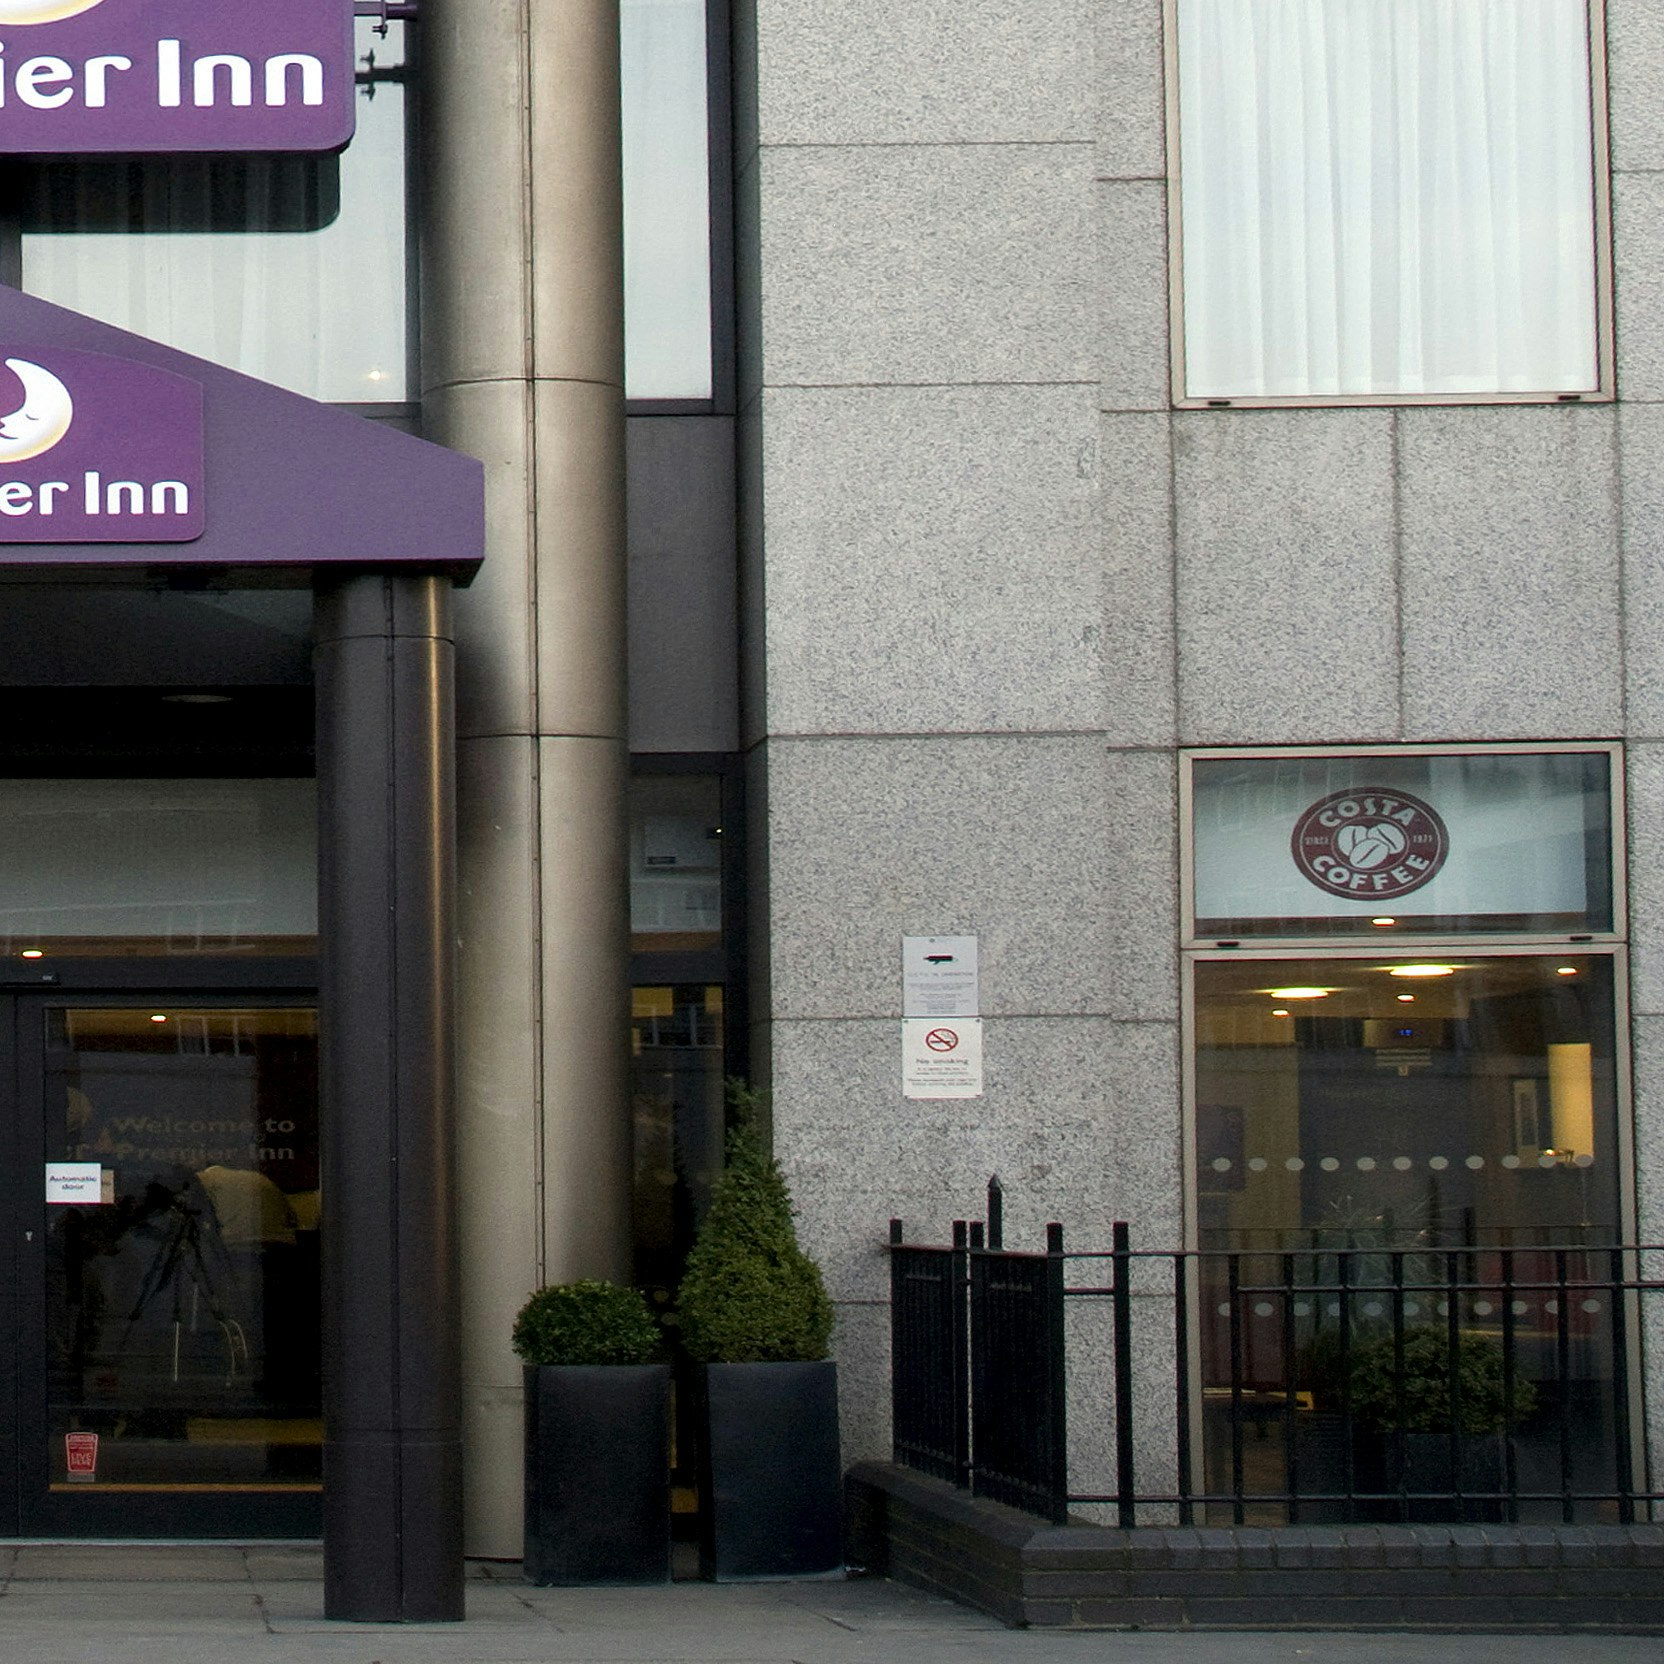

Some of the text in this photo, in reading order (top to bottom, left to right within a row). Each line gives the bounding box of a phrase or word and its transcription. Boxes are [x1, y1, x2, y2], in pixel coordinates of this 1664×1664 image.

[157, 38, 324, 108] Inn
[84, 472, 190, 516] Inn
[1318, 797, 1416, 827] COSTA
[1312, 854, 1431, 890] COFFEE
[111, 1116, 297, 1134] Welcome to
[248, 1144, 296, 1161] Inn
